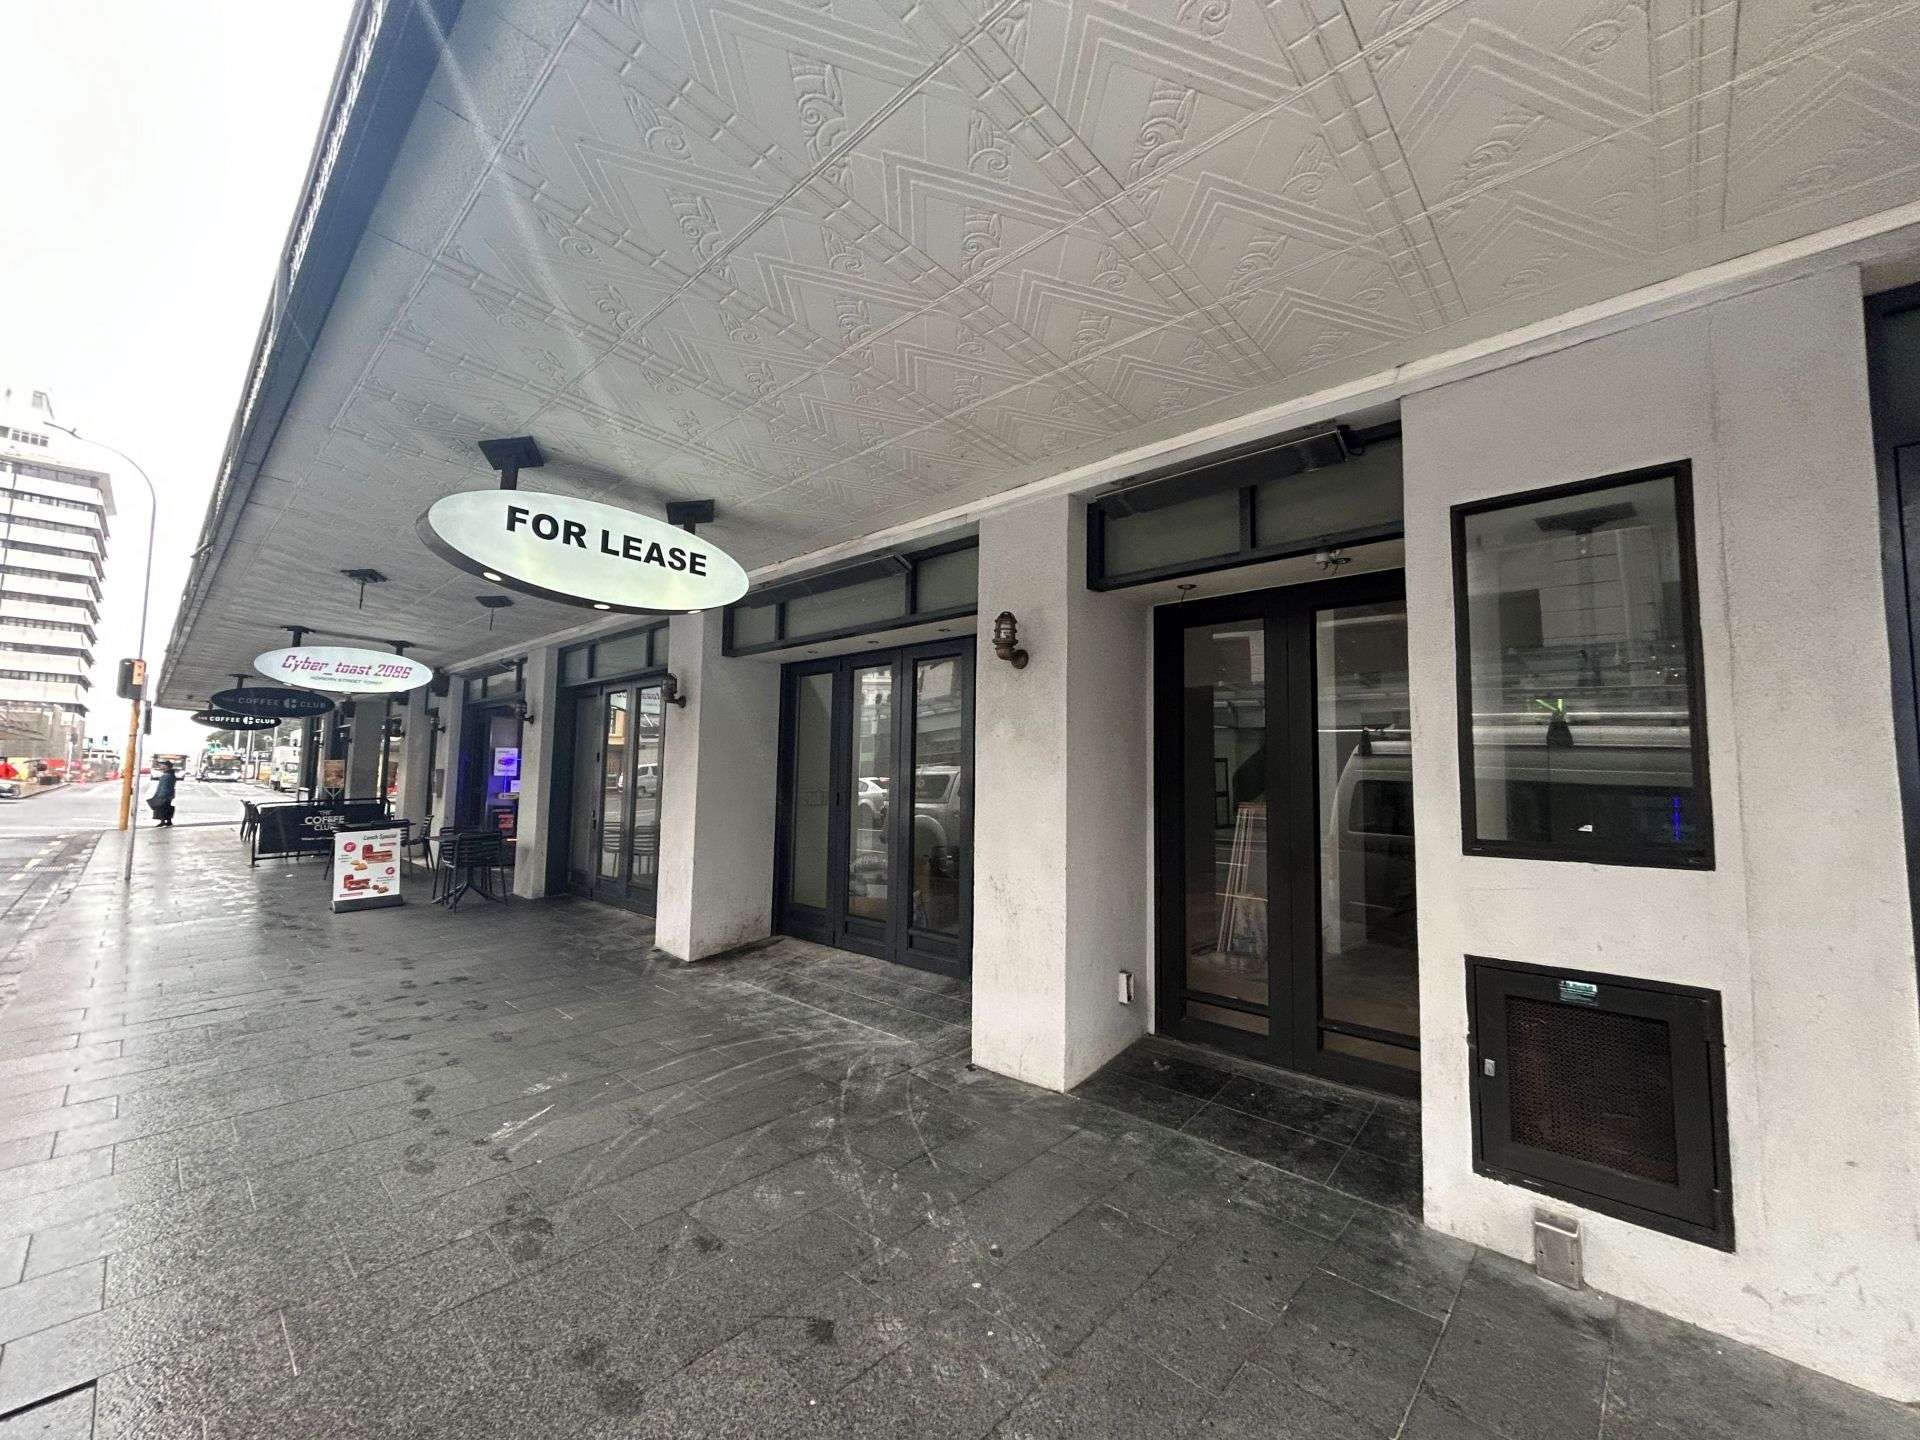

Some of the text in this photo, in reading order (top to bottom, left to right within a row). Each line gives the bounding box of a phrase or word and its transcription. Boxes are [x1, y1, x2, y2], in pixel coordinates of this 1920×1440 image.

[506, 505, 707, 577] FOR LEASE
[238, 697, 278, 706] COFFEE
